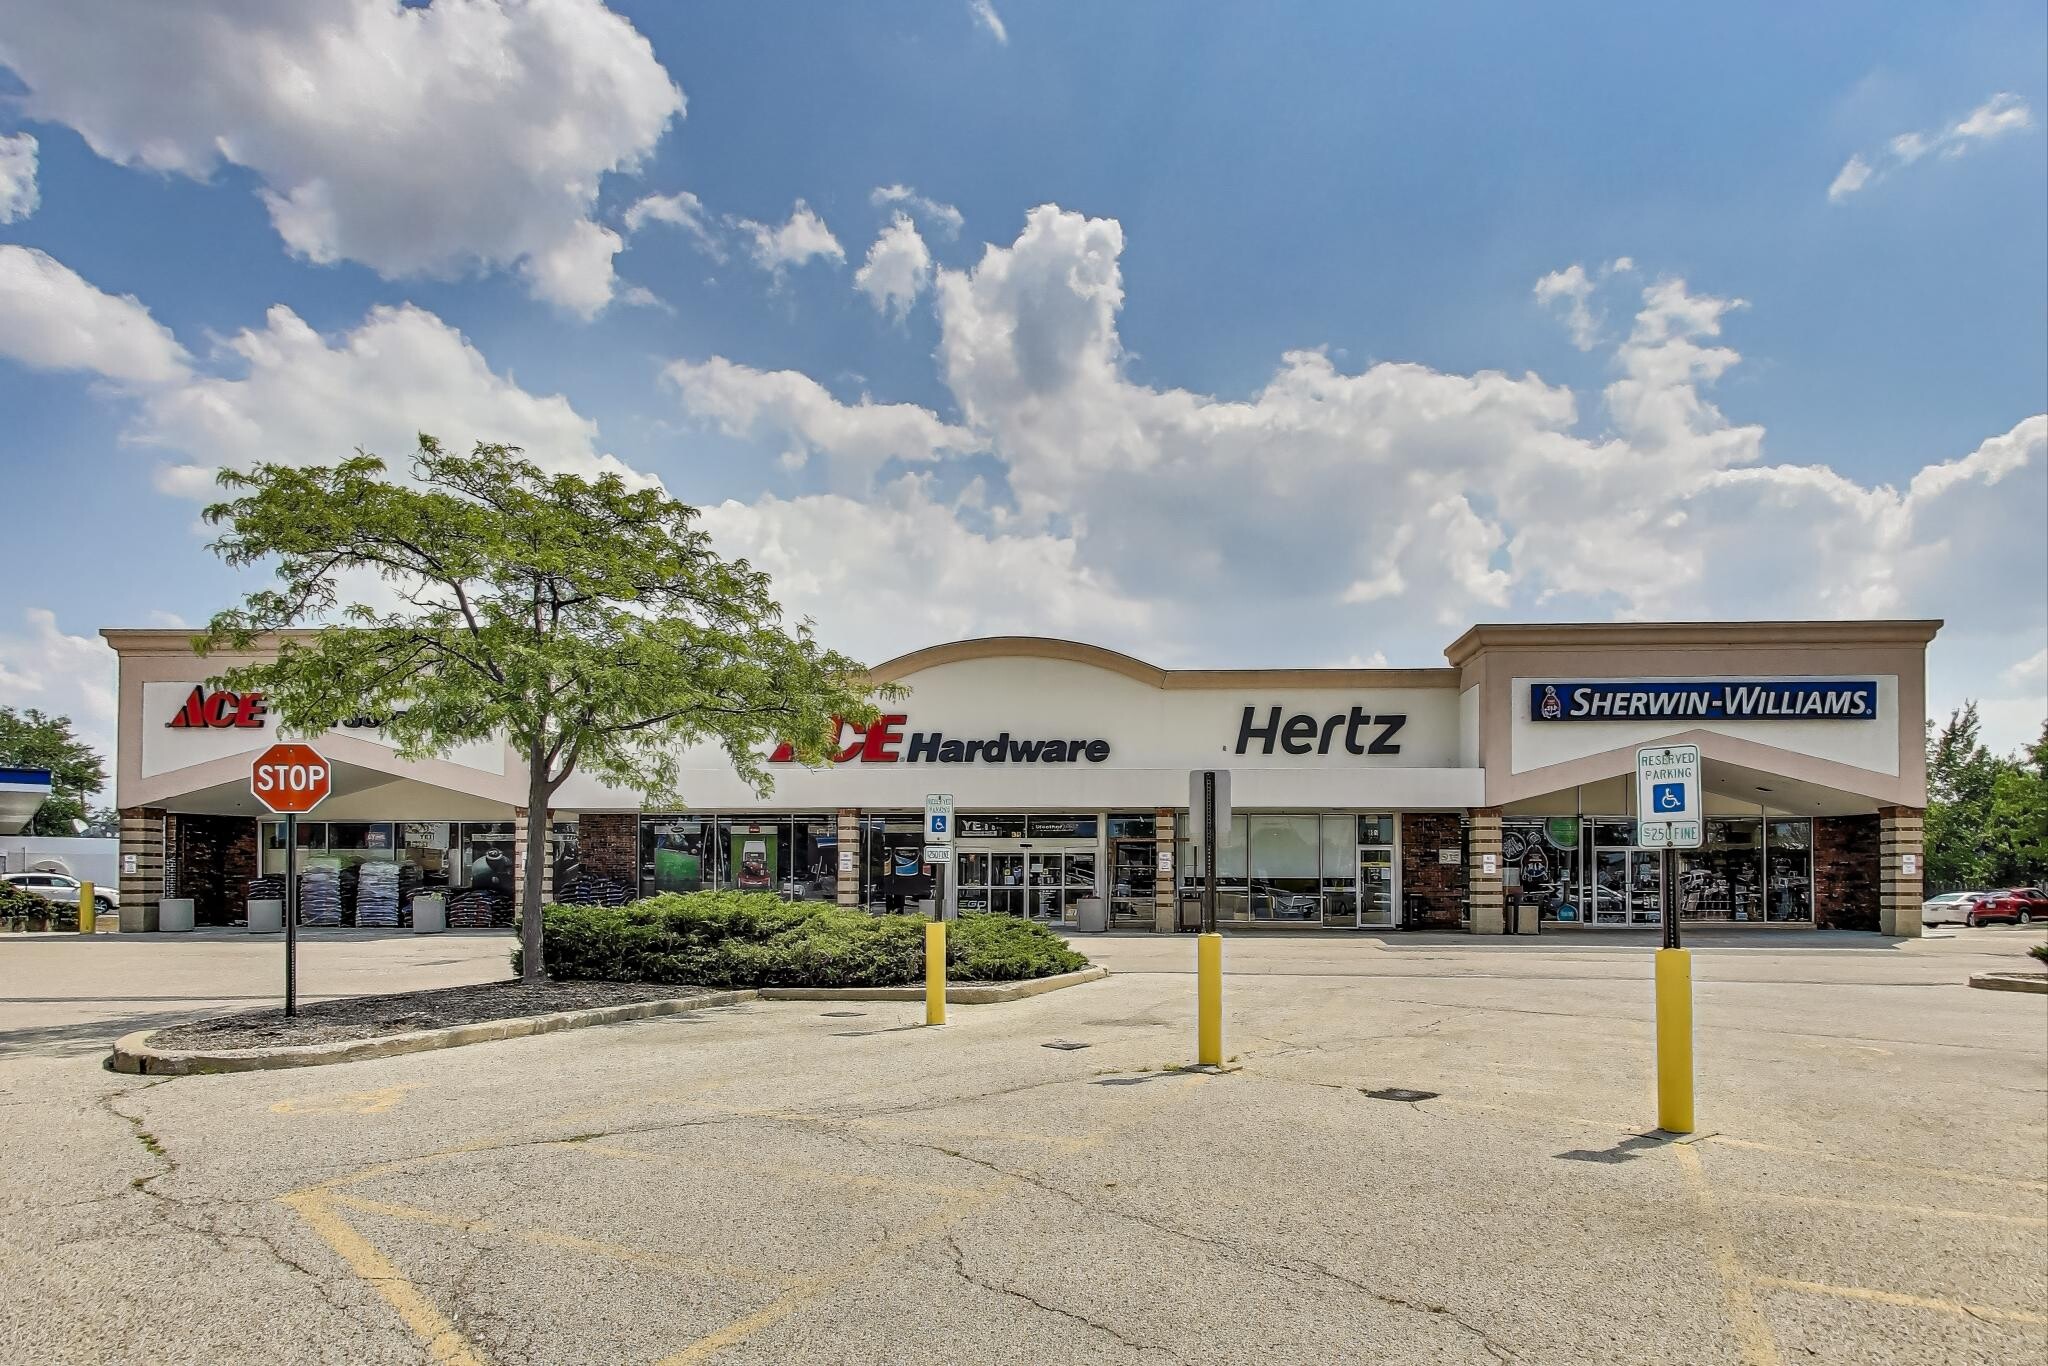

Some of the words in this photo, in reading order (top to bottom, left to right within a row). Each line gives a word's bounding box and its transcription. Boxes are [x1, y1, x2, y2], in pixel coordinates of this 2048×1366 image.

[167, 685, 267, 729] ACE
[768, 713, 908, 763] CE
[906, 732, 1111, 764] Hardware
[1235, 705, 1407, 755] Hertz
[1641, 752, 1695, 767] RESERVED
[257, 764, 326, 792] STOP
[1645, 767, 1692, 781] PARKING
[1643, 827, 1672, 841] $250
[1674, 826, 1697, 841] FINE
